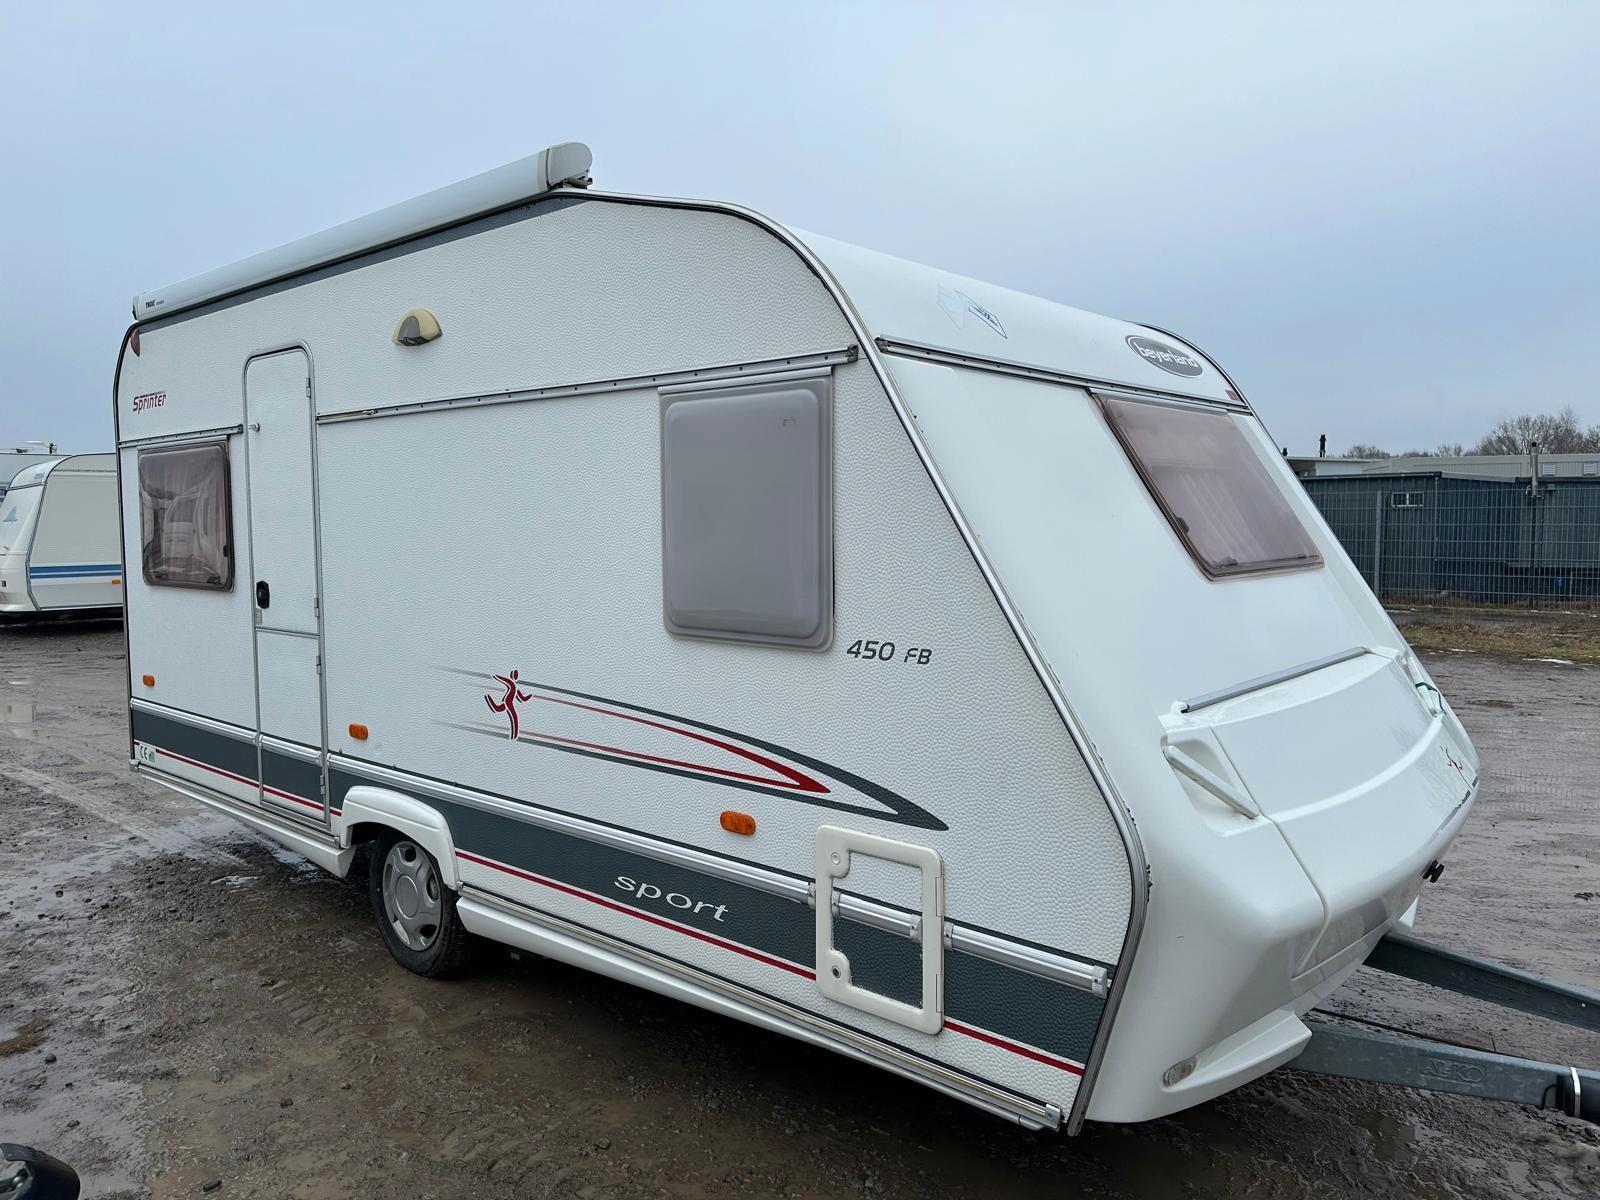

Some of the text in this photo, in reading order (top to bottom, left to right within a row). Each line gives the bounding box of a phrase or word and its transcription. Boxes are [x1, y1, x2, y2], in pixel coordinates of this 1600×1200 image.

[1133, 341, 1200, 368] beyerland
[132, 393, 167, 415] Sprinter
[846, 639, 933, 665] 450 FB
[614, 876, 729, 922] sport
